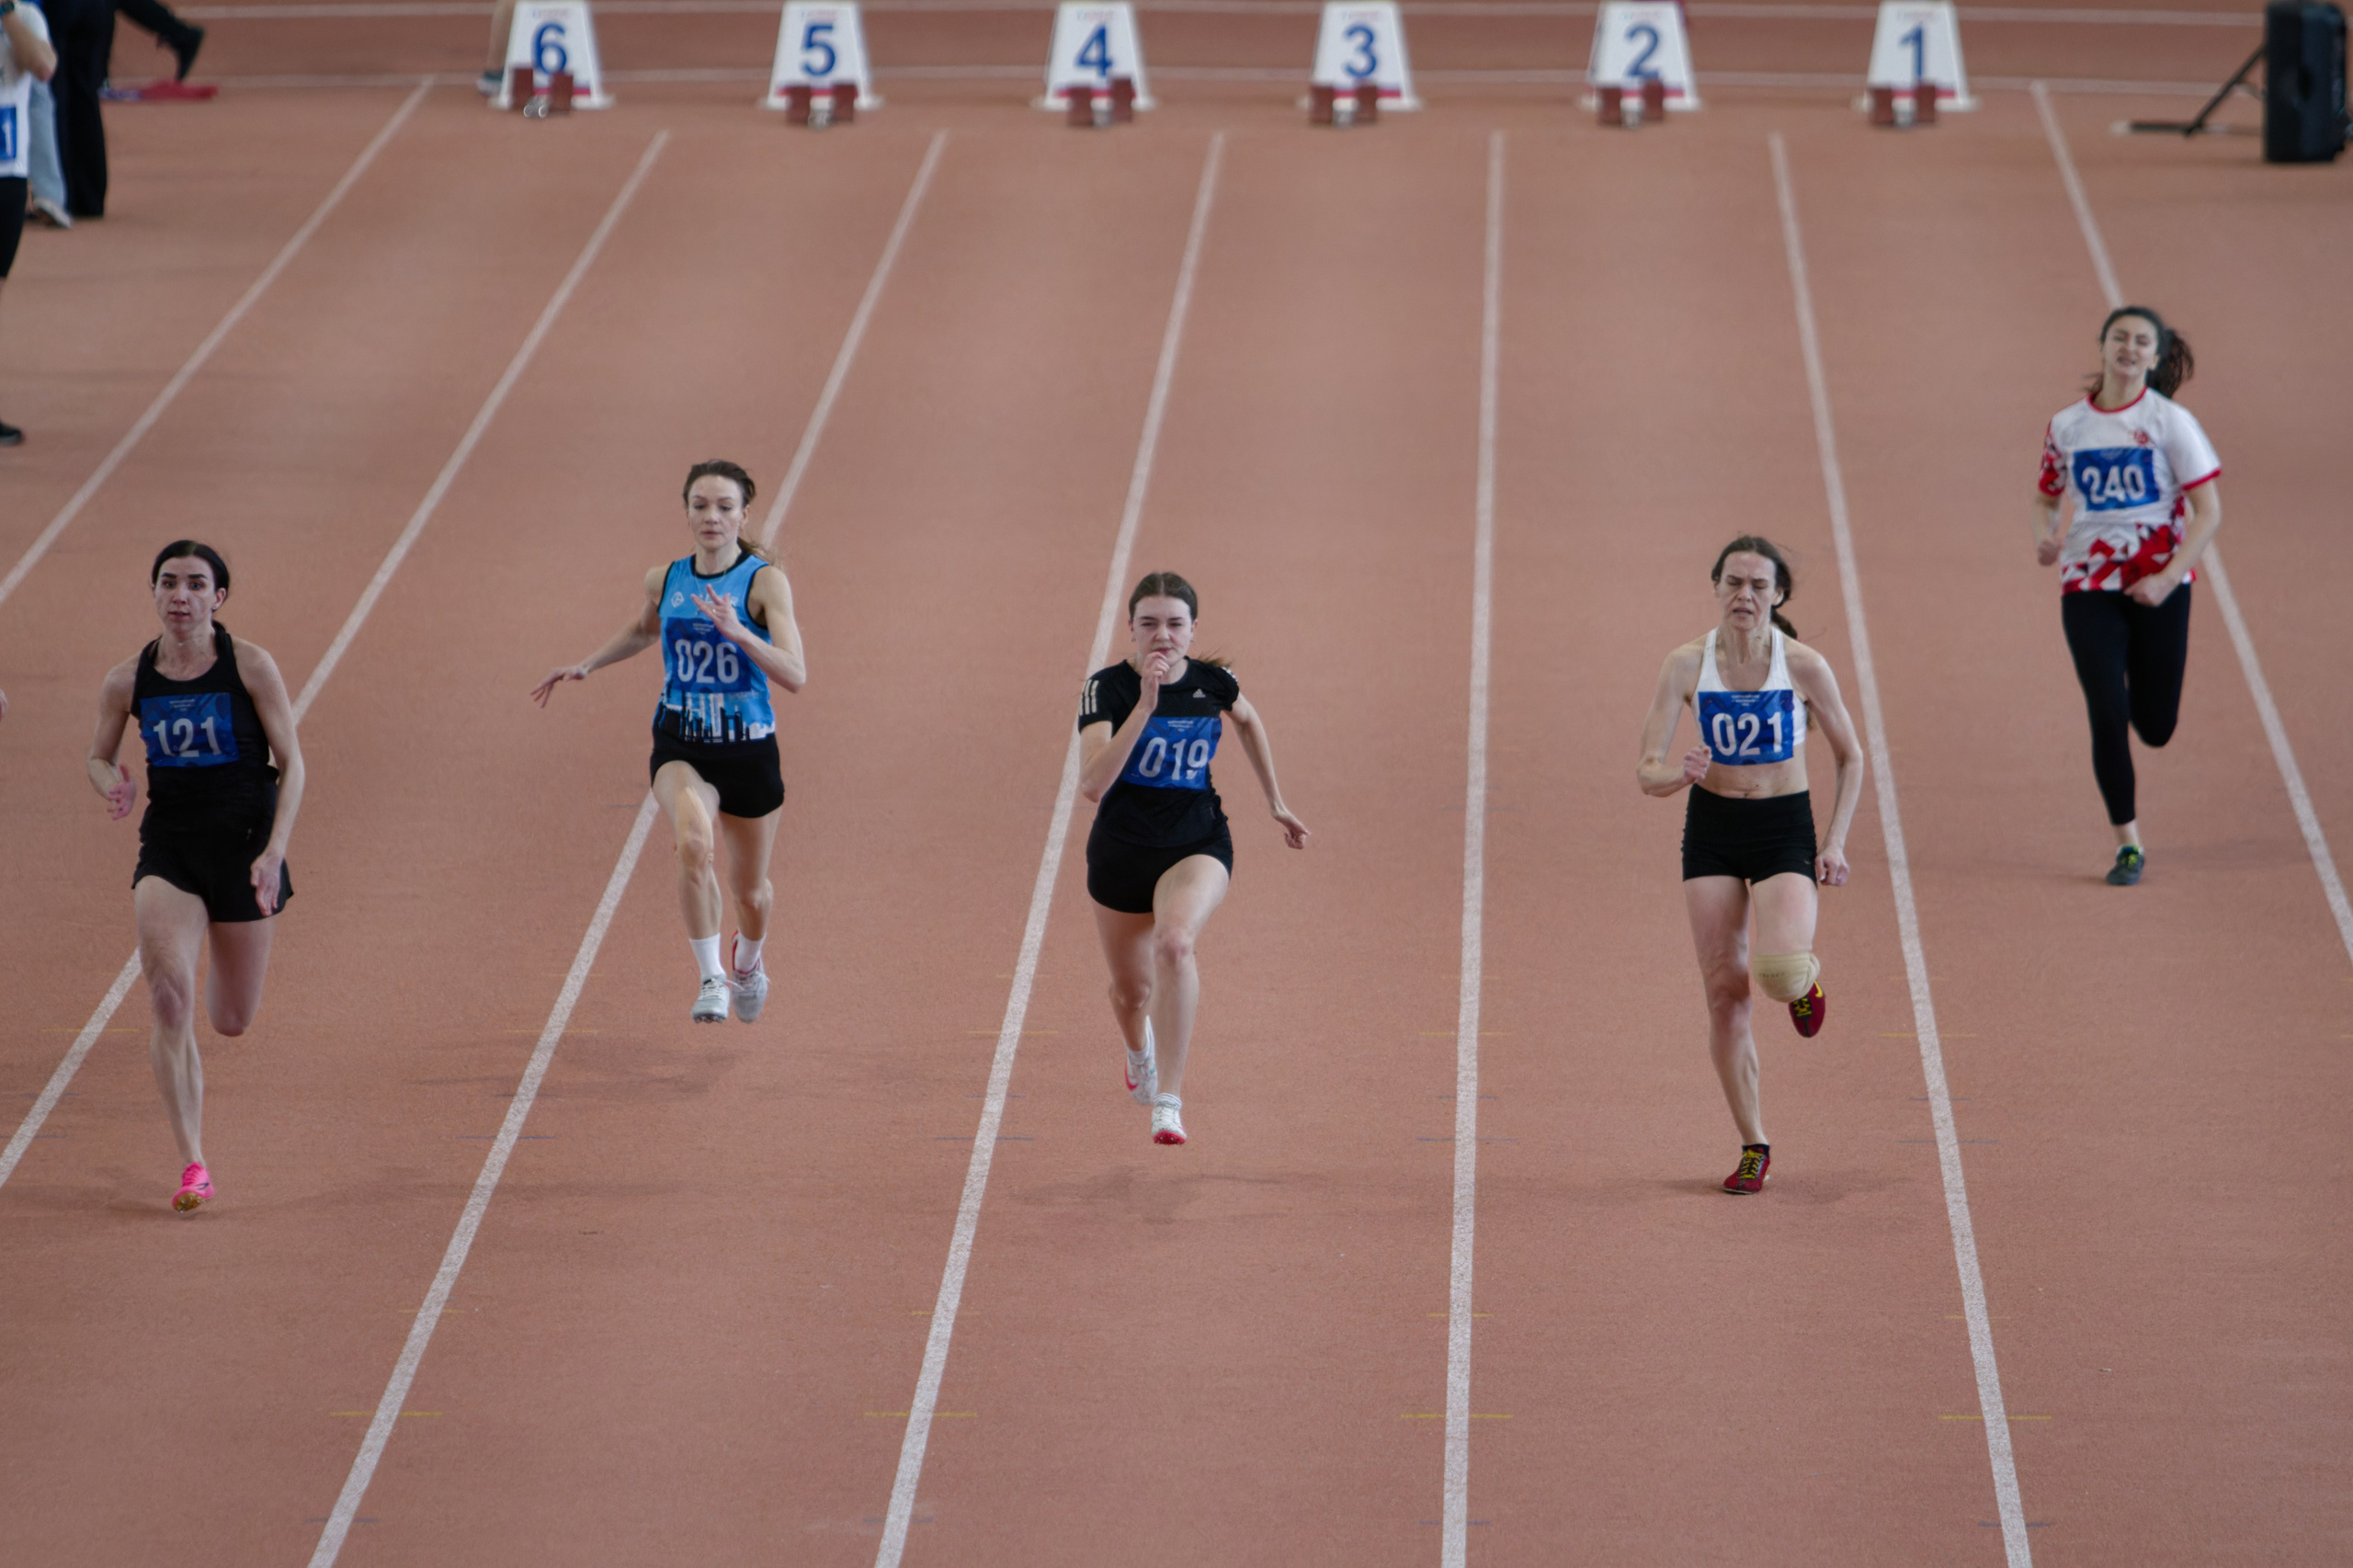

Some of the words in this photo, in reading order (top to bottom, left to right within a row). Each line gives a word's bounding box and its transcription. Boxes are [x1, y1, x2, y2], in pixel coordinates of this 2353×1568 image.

[531, 21, 567, 75] 6
[801, 23, 835, 76] 5
[1075, 23, 1114, 77] 4
[1344, 24, 1377, 78] 3
[1625, 24, 1659, 80] 2
[1898, 23, 1924, 82] 1
[2081, 463, 2146, 504] 240
[675, 639, 740, 684] 026
[153, 716, 222, 758] 121
[1138, 736, 1210, 780] 019
[1711, 710, 1783, 756] 021
